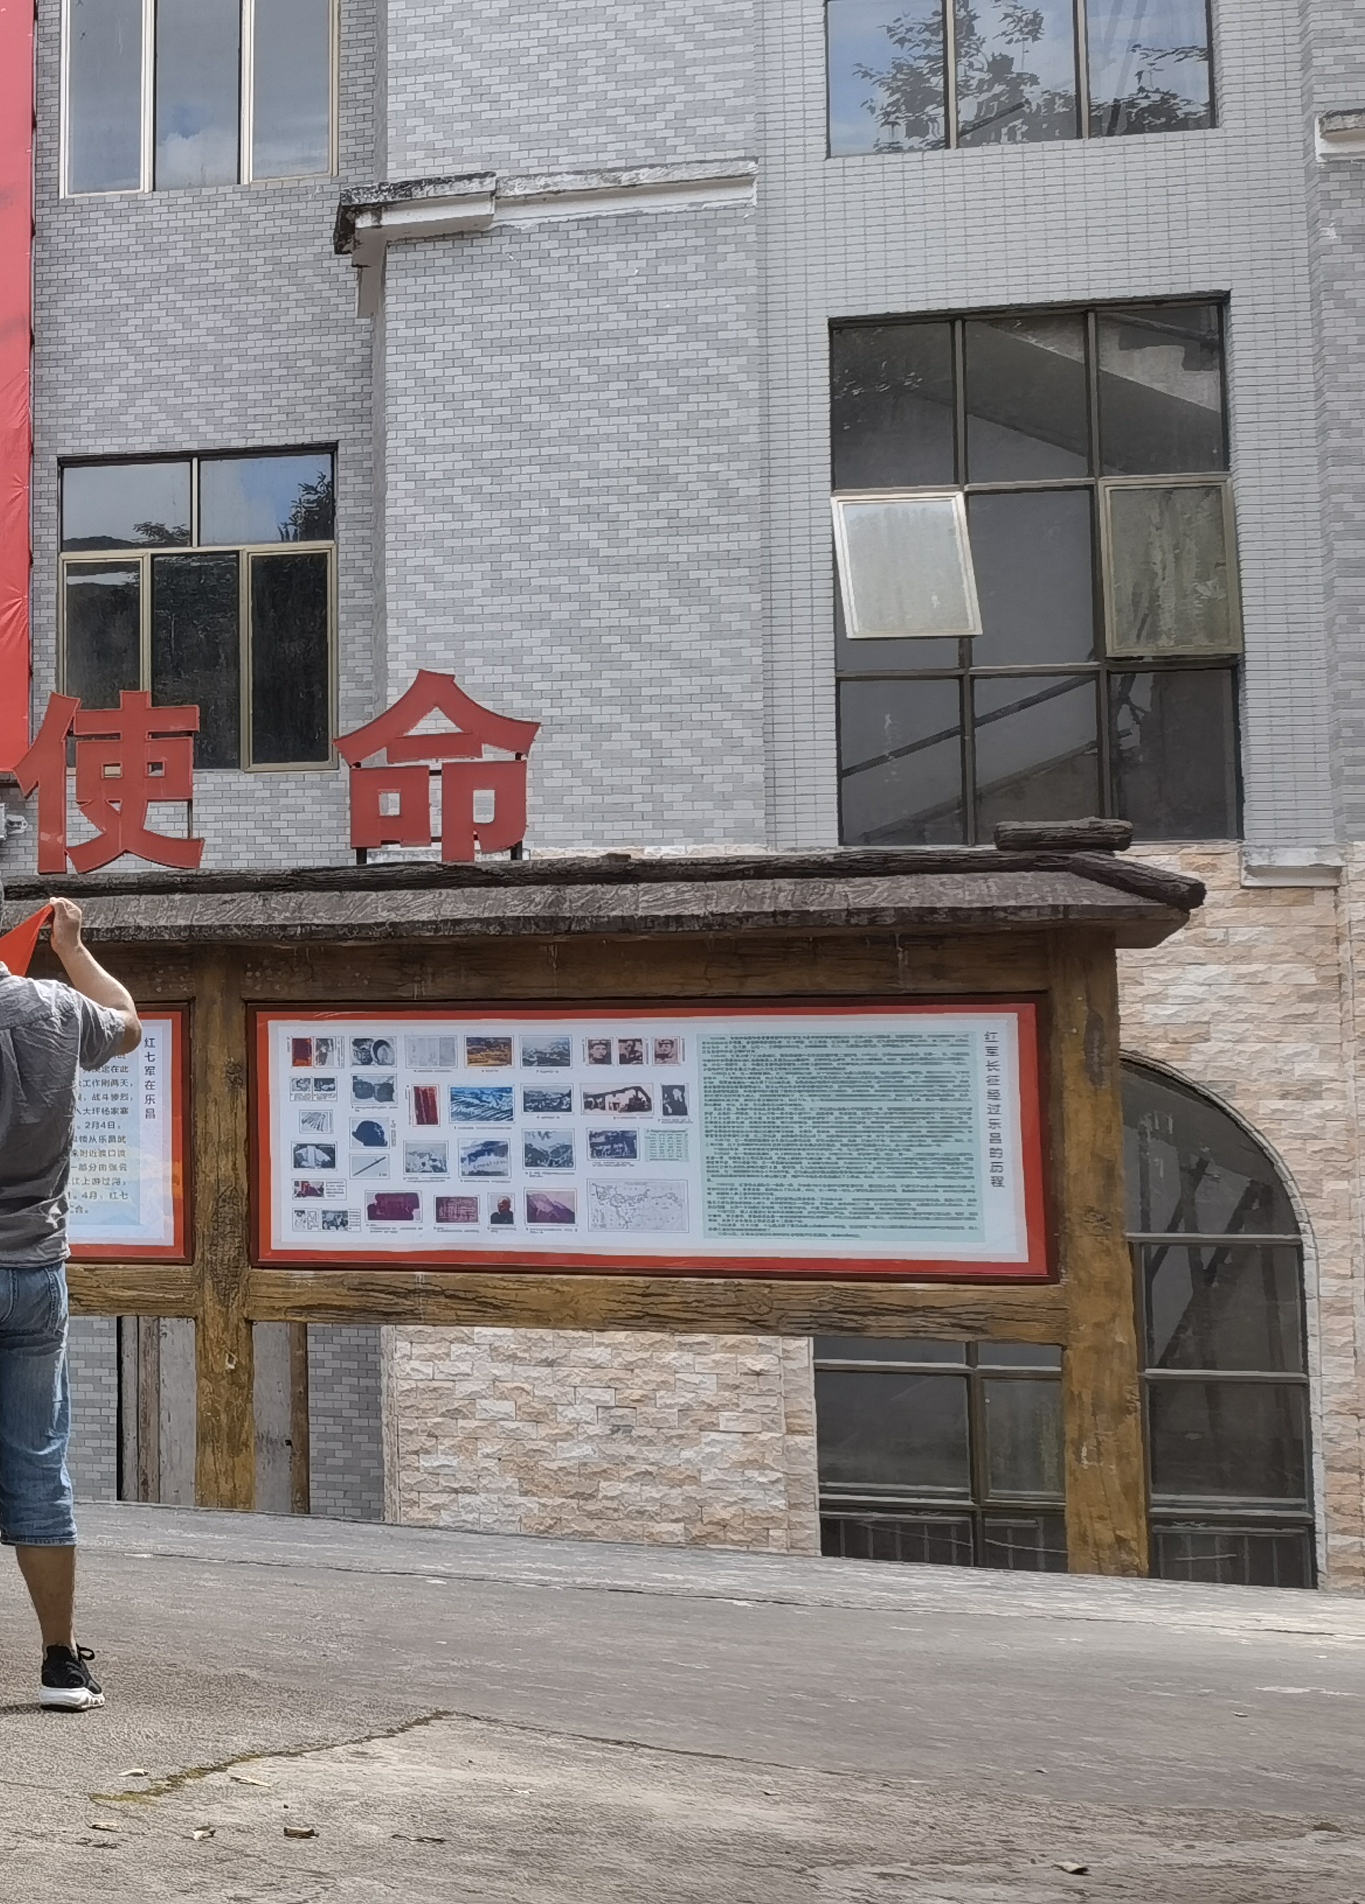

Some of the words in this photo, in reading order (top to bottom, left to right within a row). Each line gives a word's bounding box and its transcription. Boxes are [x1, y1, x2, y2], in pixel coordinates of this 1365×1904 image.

[143, 1036, 157, 1120] 红七军在乐昌
